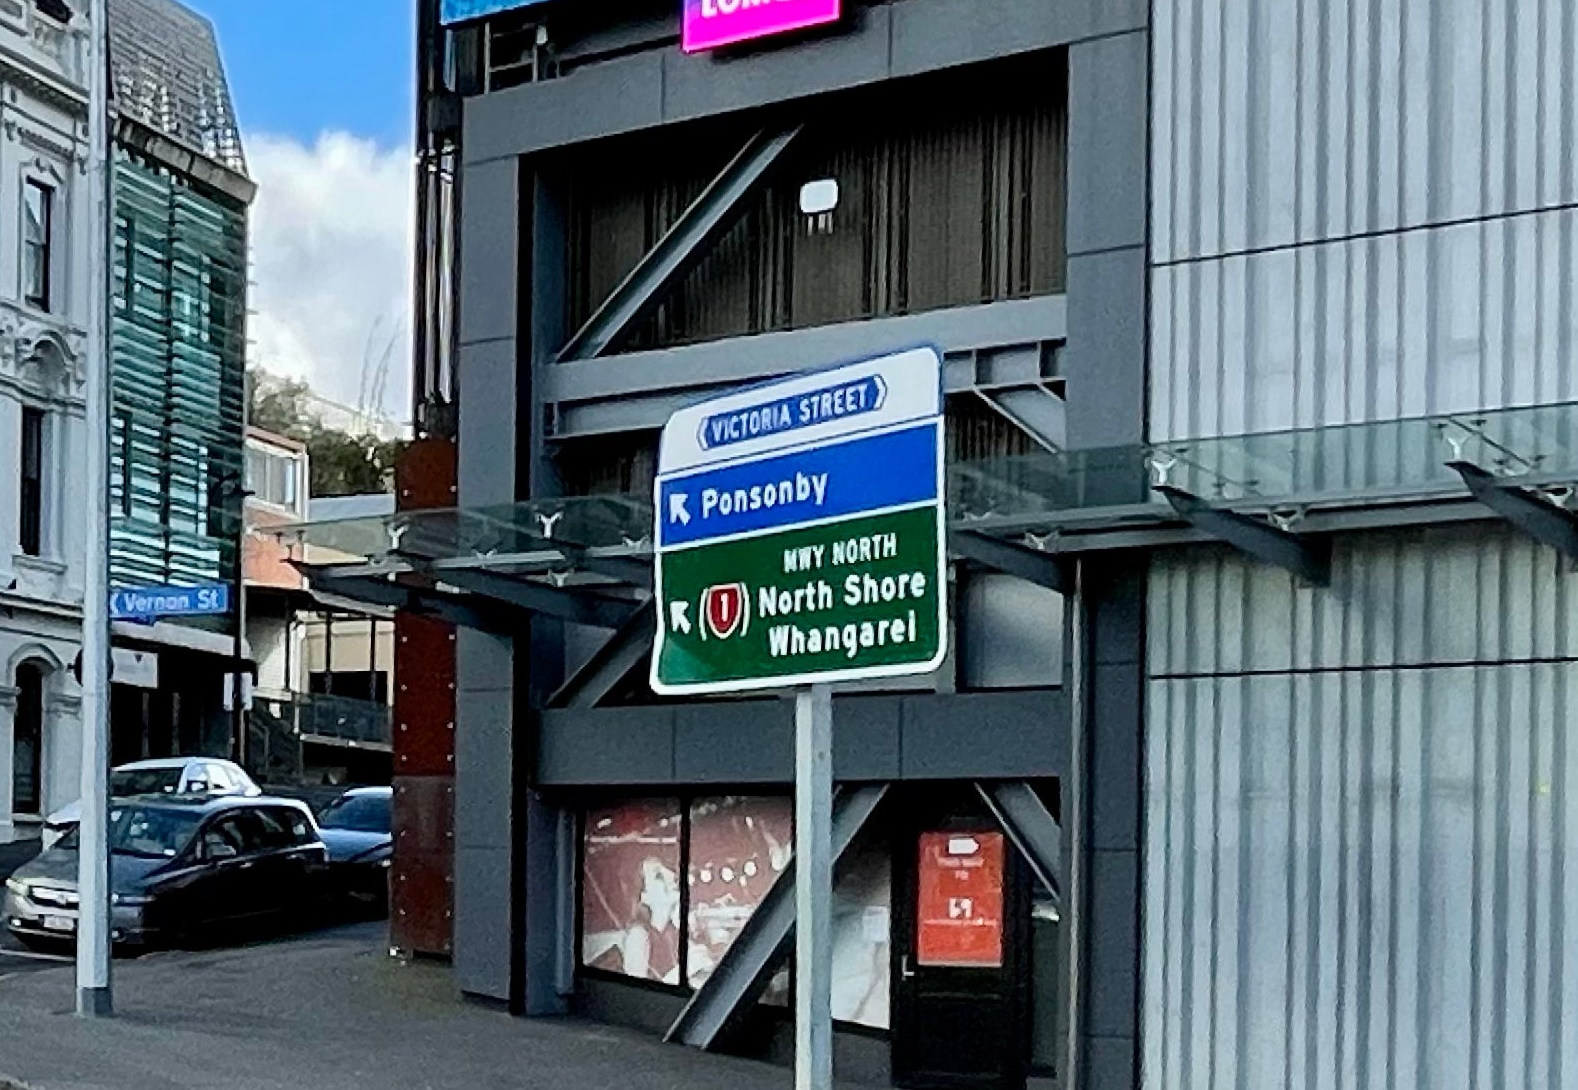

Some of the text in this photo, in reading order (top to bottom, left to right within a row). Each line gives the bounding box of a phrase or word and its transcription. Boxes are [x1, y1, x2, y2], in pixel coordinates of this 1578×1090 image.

[711, 383, 868, 443] VICTORIA STREET
[701, 471, 828, 519] Ponsonby
[783, 532, 897, 574] MWY NORTH
[123, 589, 219, 612] Vernon St
[720, 593, 729, 622] 1
[758, 571, 926, 618] North Shore
[768, 610, 917, 659] Whangarei
